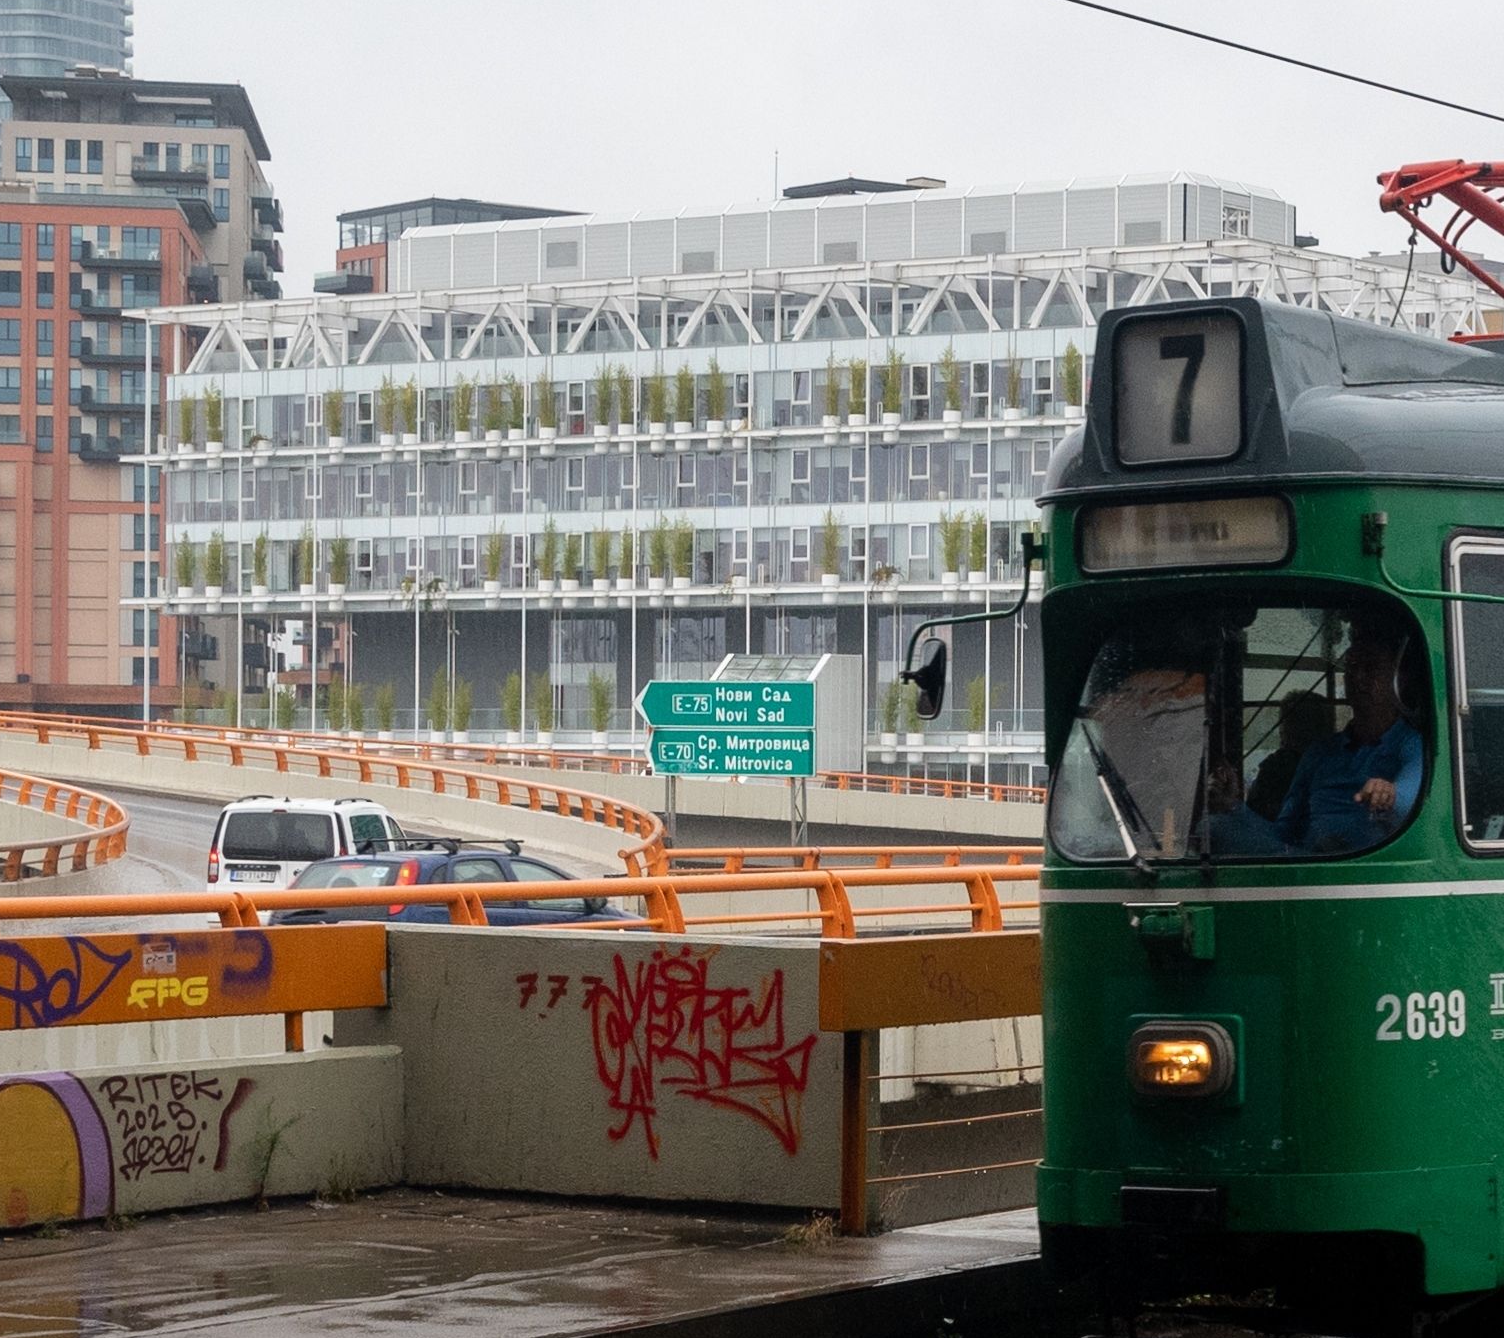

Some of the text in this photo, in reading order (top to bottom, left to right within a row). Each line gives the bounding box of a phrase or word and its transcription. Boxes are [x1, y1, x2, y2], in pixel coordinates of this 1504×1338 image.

[1160, 334, 1205, 445] 7
[715, 686, 792, 703] Нови Сад
[675, 695, 709, 713] E-75
[715, 706, 785, 723] Novi Sad
[660, 743, 693, 760] E-70
[697, 735, 810, 753] Ср. Митровица
[697, 756, 719, 771] Sr.
[725, 755, 793, 772] Mitrovica
[1375, 988, 1467, 1041] 2639
